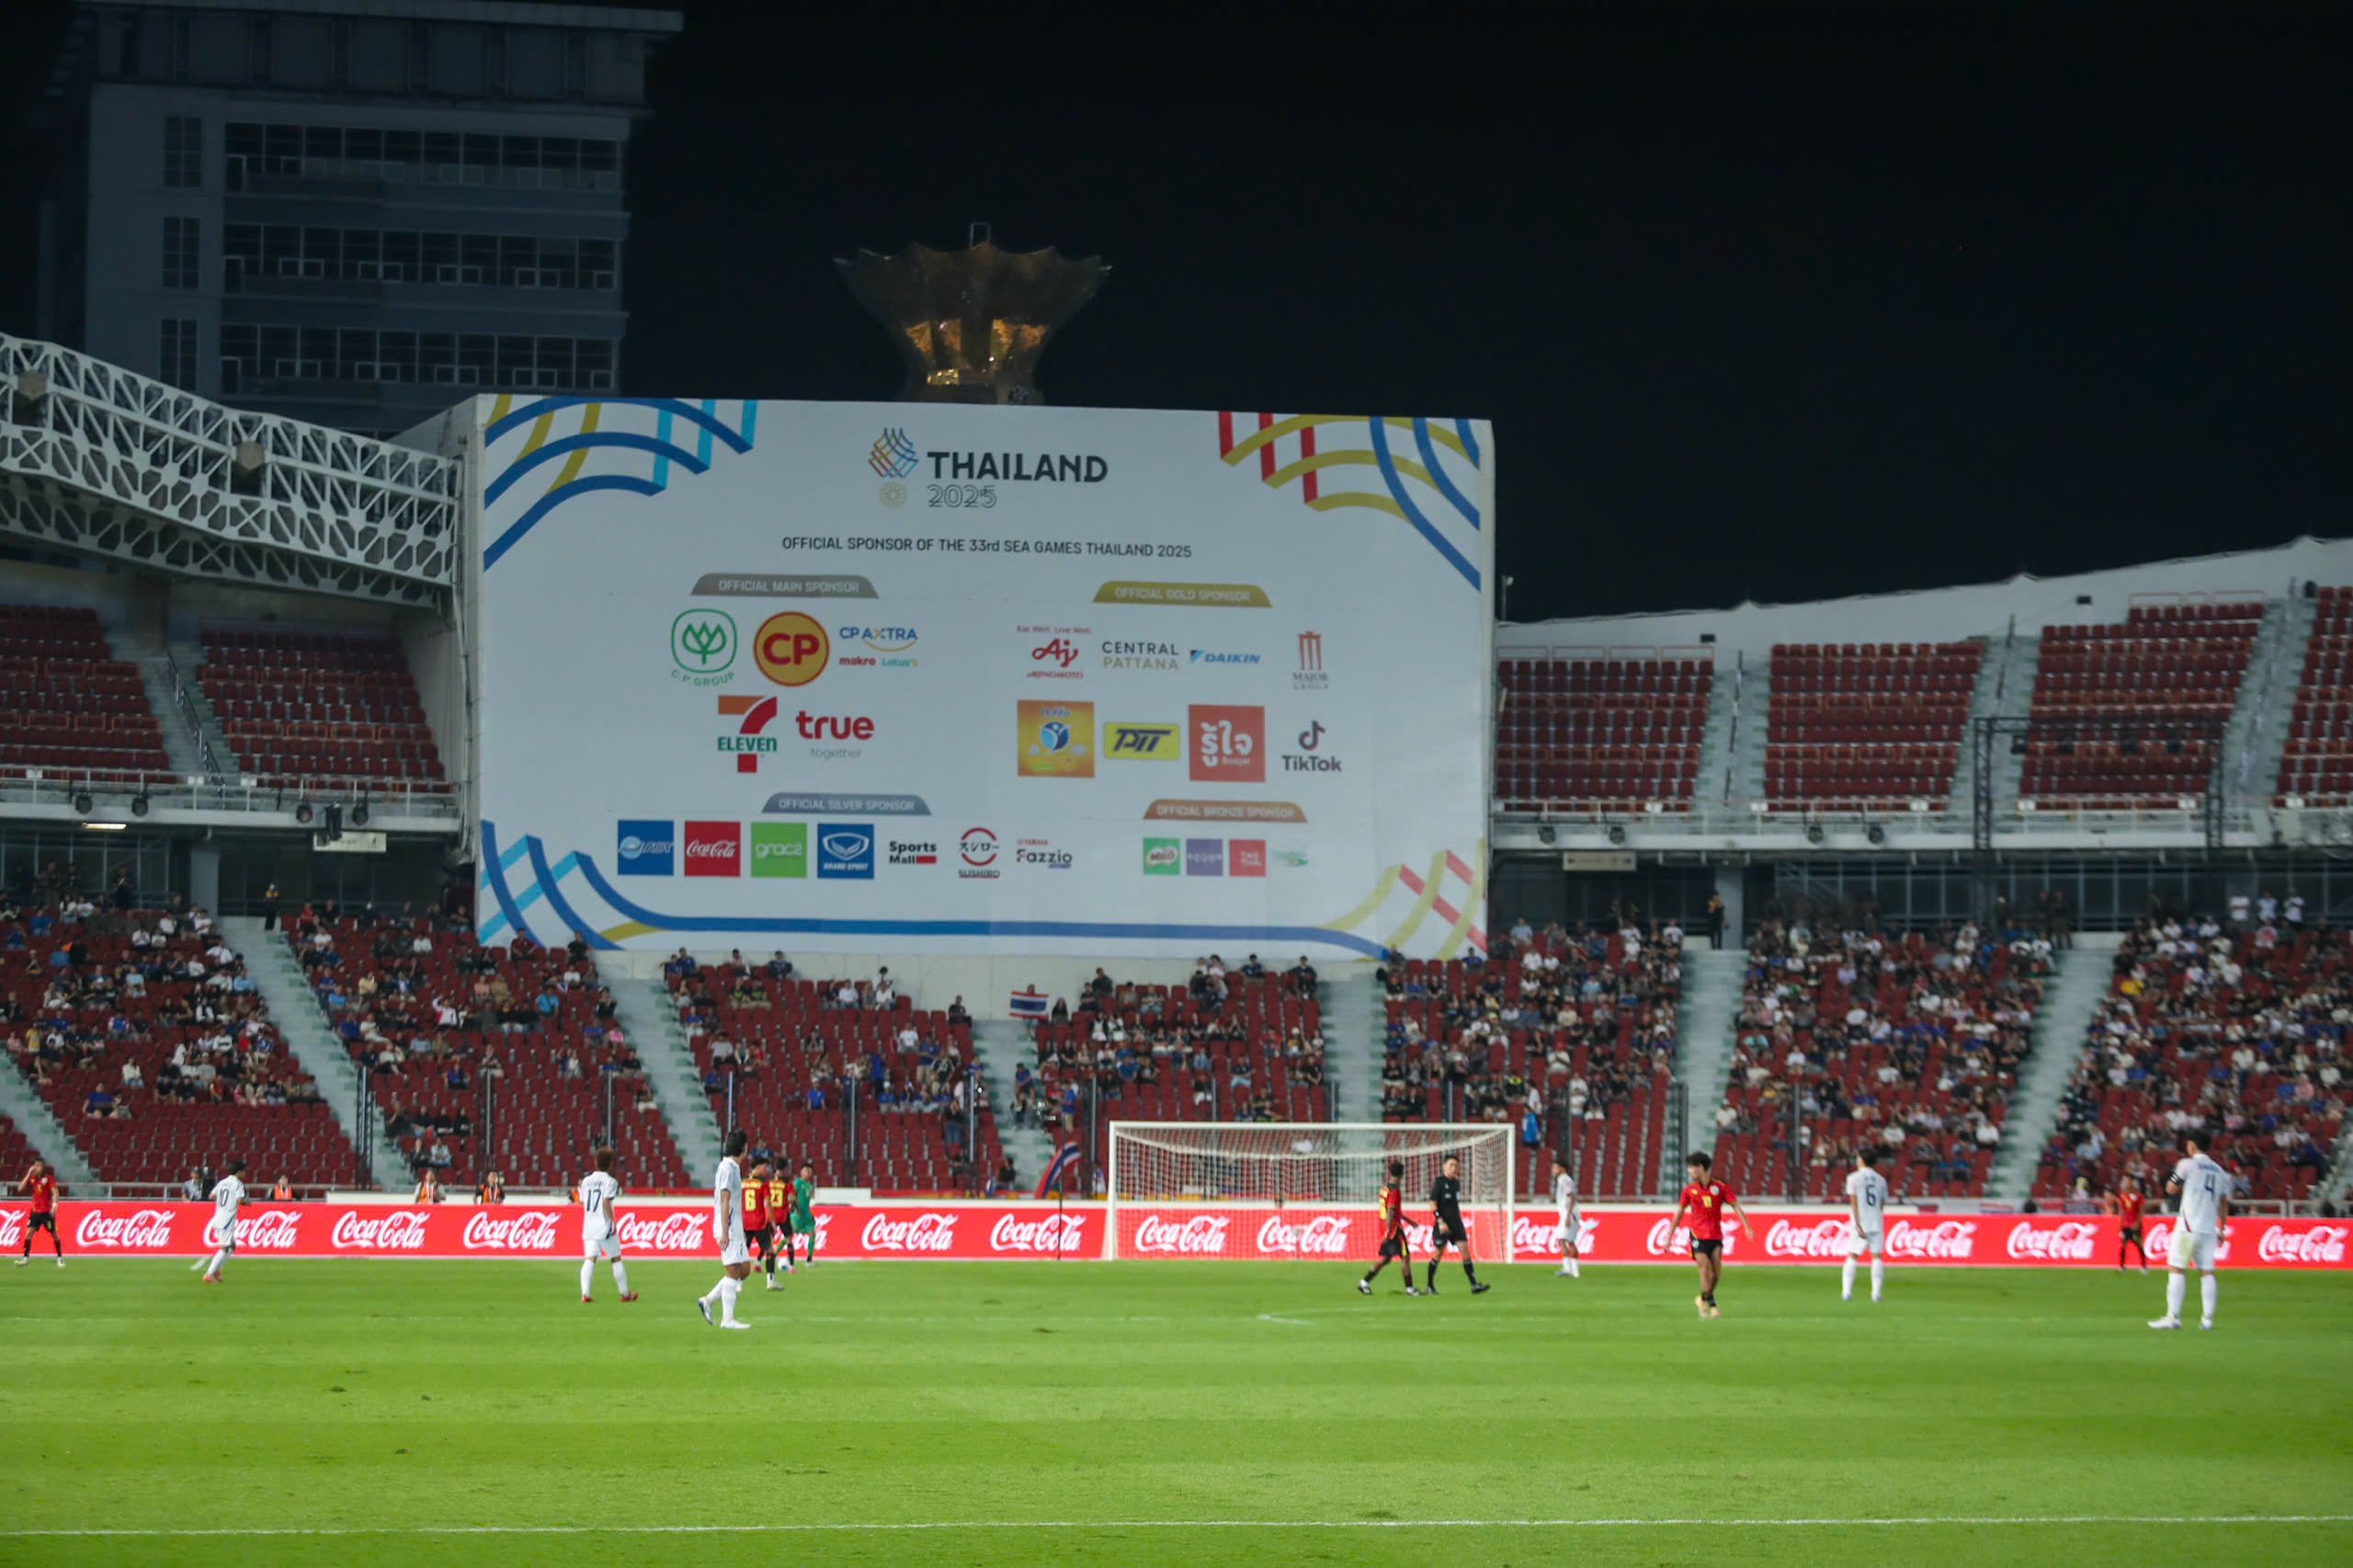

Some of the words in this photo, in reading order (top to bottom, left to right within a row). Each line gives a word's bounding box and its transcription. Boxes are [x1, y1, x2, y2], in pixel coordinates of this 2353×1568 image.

[926, 451, 1108, 483] THAILAND
[926, 483, 997, 508] 2025
[782, 537, 843, 551] OFFICIAL
[847, 537, 913, 551] SPONSOR
[916, 539, 935, 552] OF
[938, 539, 965, 552] THE
[969, 539, 1000, 552] 33rd
[1004, 540, 1030, 553] SEA
[1034, 540, 1082, 554] GAMES
[1086, 542, 1154, 557] THAILAND
[1157, 544, 1192, 558] 2025
[719, 580, 769, 593] OFFICIAL
[772, 581, 802, 593] MAIN
[805, 581, 859, 593] SPONSOR
[1115, 587, 1163, 599] OFFICIAL
[1166, 589, 1196, 600] GOLD
[1199, 590, 1250, 602] SPONSOR
[839, 627, 860, 640] CP
[862, 627, 918, 641] AXTRA
[763, 632, 821, 665] CP
[1102, 641, 1179, 655] CENTRAL
[1204, 653, 1261, 664] DAIKIN
[839, 654, 876, 667] makro
[1103, 656, 1179, 670] PATTANA
[796, 710, 875, 741] true
[1113, 728, 1174, 753] PTT
[811, 748, 862, 761] together
[1281, 754, 1342, 772] TikTok
[779, 799, 824, 810] OFFICIAL
[828, 800, 863, 811] SILVER
[866, 801, 915, 812] SPONSOR
[1156, 804, 1200, 816] OFFICIAL
[889, 841, 937, 857] Sports
[961, 842, 1000, 852] スシロー
[1016, 848, 1073, 864] Fazzio
[889, 856, 915, 865] Mall
[1865, 1184, 1877, 1206] 6
[2204, 1174, 2217, 1195] 4
[220, 1188, 231, 1208] 10
[586, 1188, 602, 1213] 17
[76, 1209, 177, 1248] Coca-Cola
[331, 1210, 432, 1248] Coca-Cola
[464, 1210, 563, 1249] Coca-Cola
[862, 1212, 959, 1251] Coca-Cola
[992, 1213, 1088, 1252] Coca-Cola
[1886, 1220, 1977, 1257] Coca-Cola
[2007, 1221, 2097, 1259] Coca-Cola
[2259, 1223, 2349, 1262] Coca-Cola
